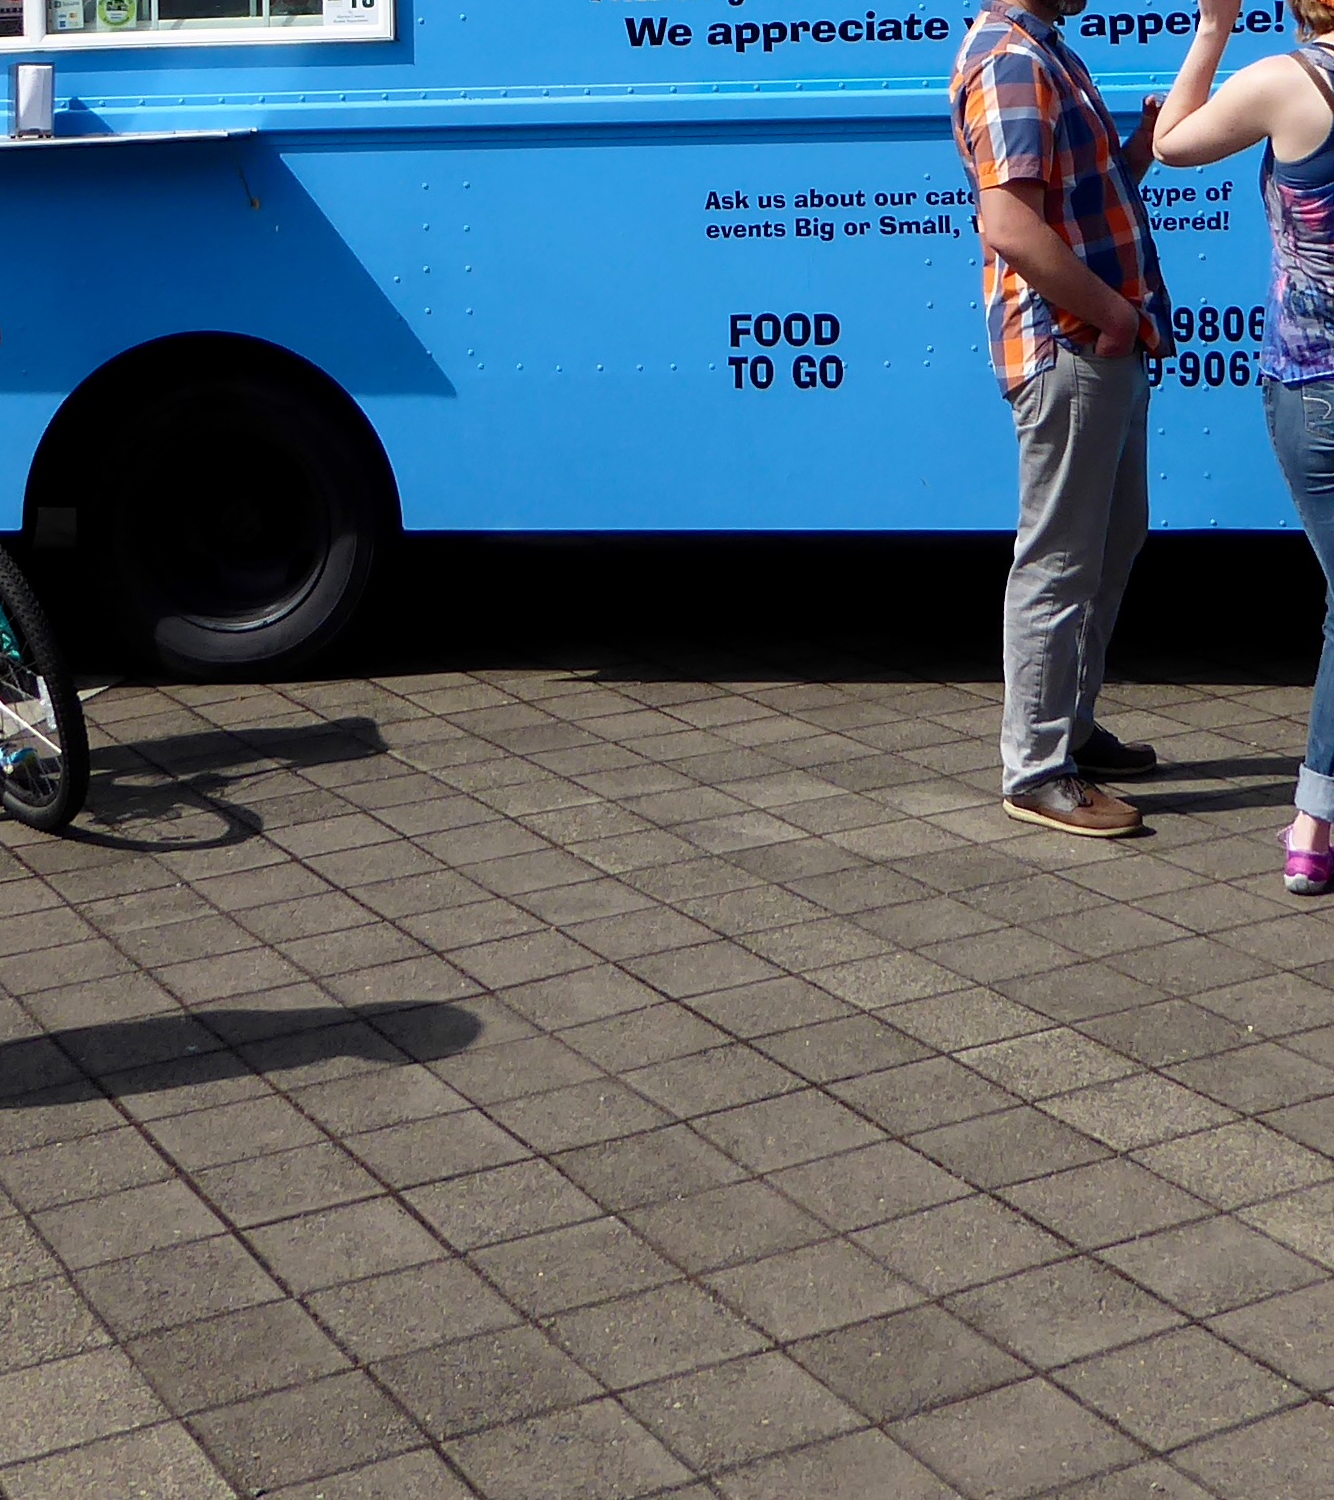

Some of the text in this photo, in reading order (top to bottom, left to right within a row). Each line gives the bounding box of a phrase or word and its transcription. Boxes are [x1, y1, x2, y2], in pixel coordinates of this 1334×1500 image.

[624, 16, 693, 48] We
[707, 10, 949, 53] appreciate
[705, 180, 1234, 211] Ask us about our cate type of
[705, 218, 787, 239] events
[794, 216, 835, 241] Big
[843, 220, 871, 237] or
[879, 214, 961, 239] Small,
[1150, 210, 1230, 231] vered!
[729, 305, 1265, 348] FOOD 9806
[727, 354, 774, 389] TO
[792, 354, 844, 389] GO
